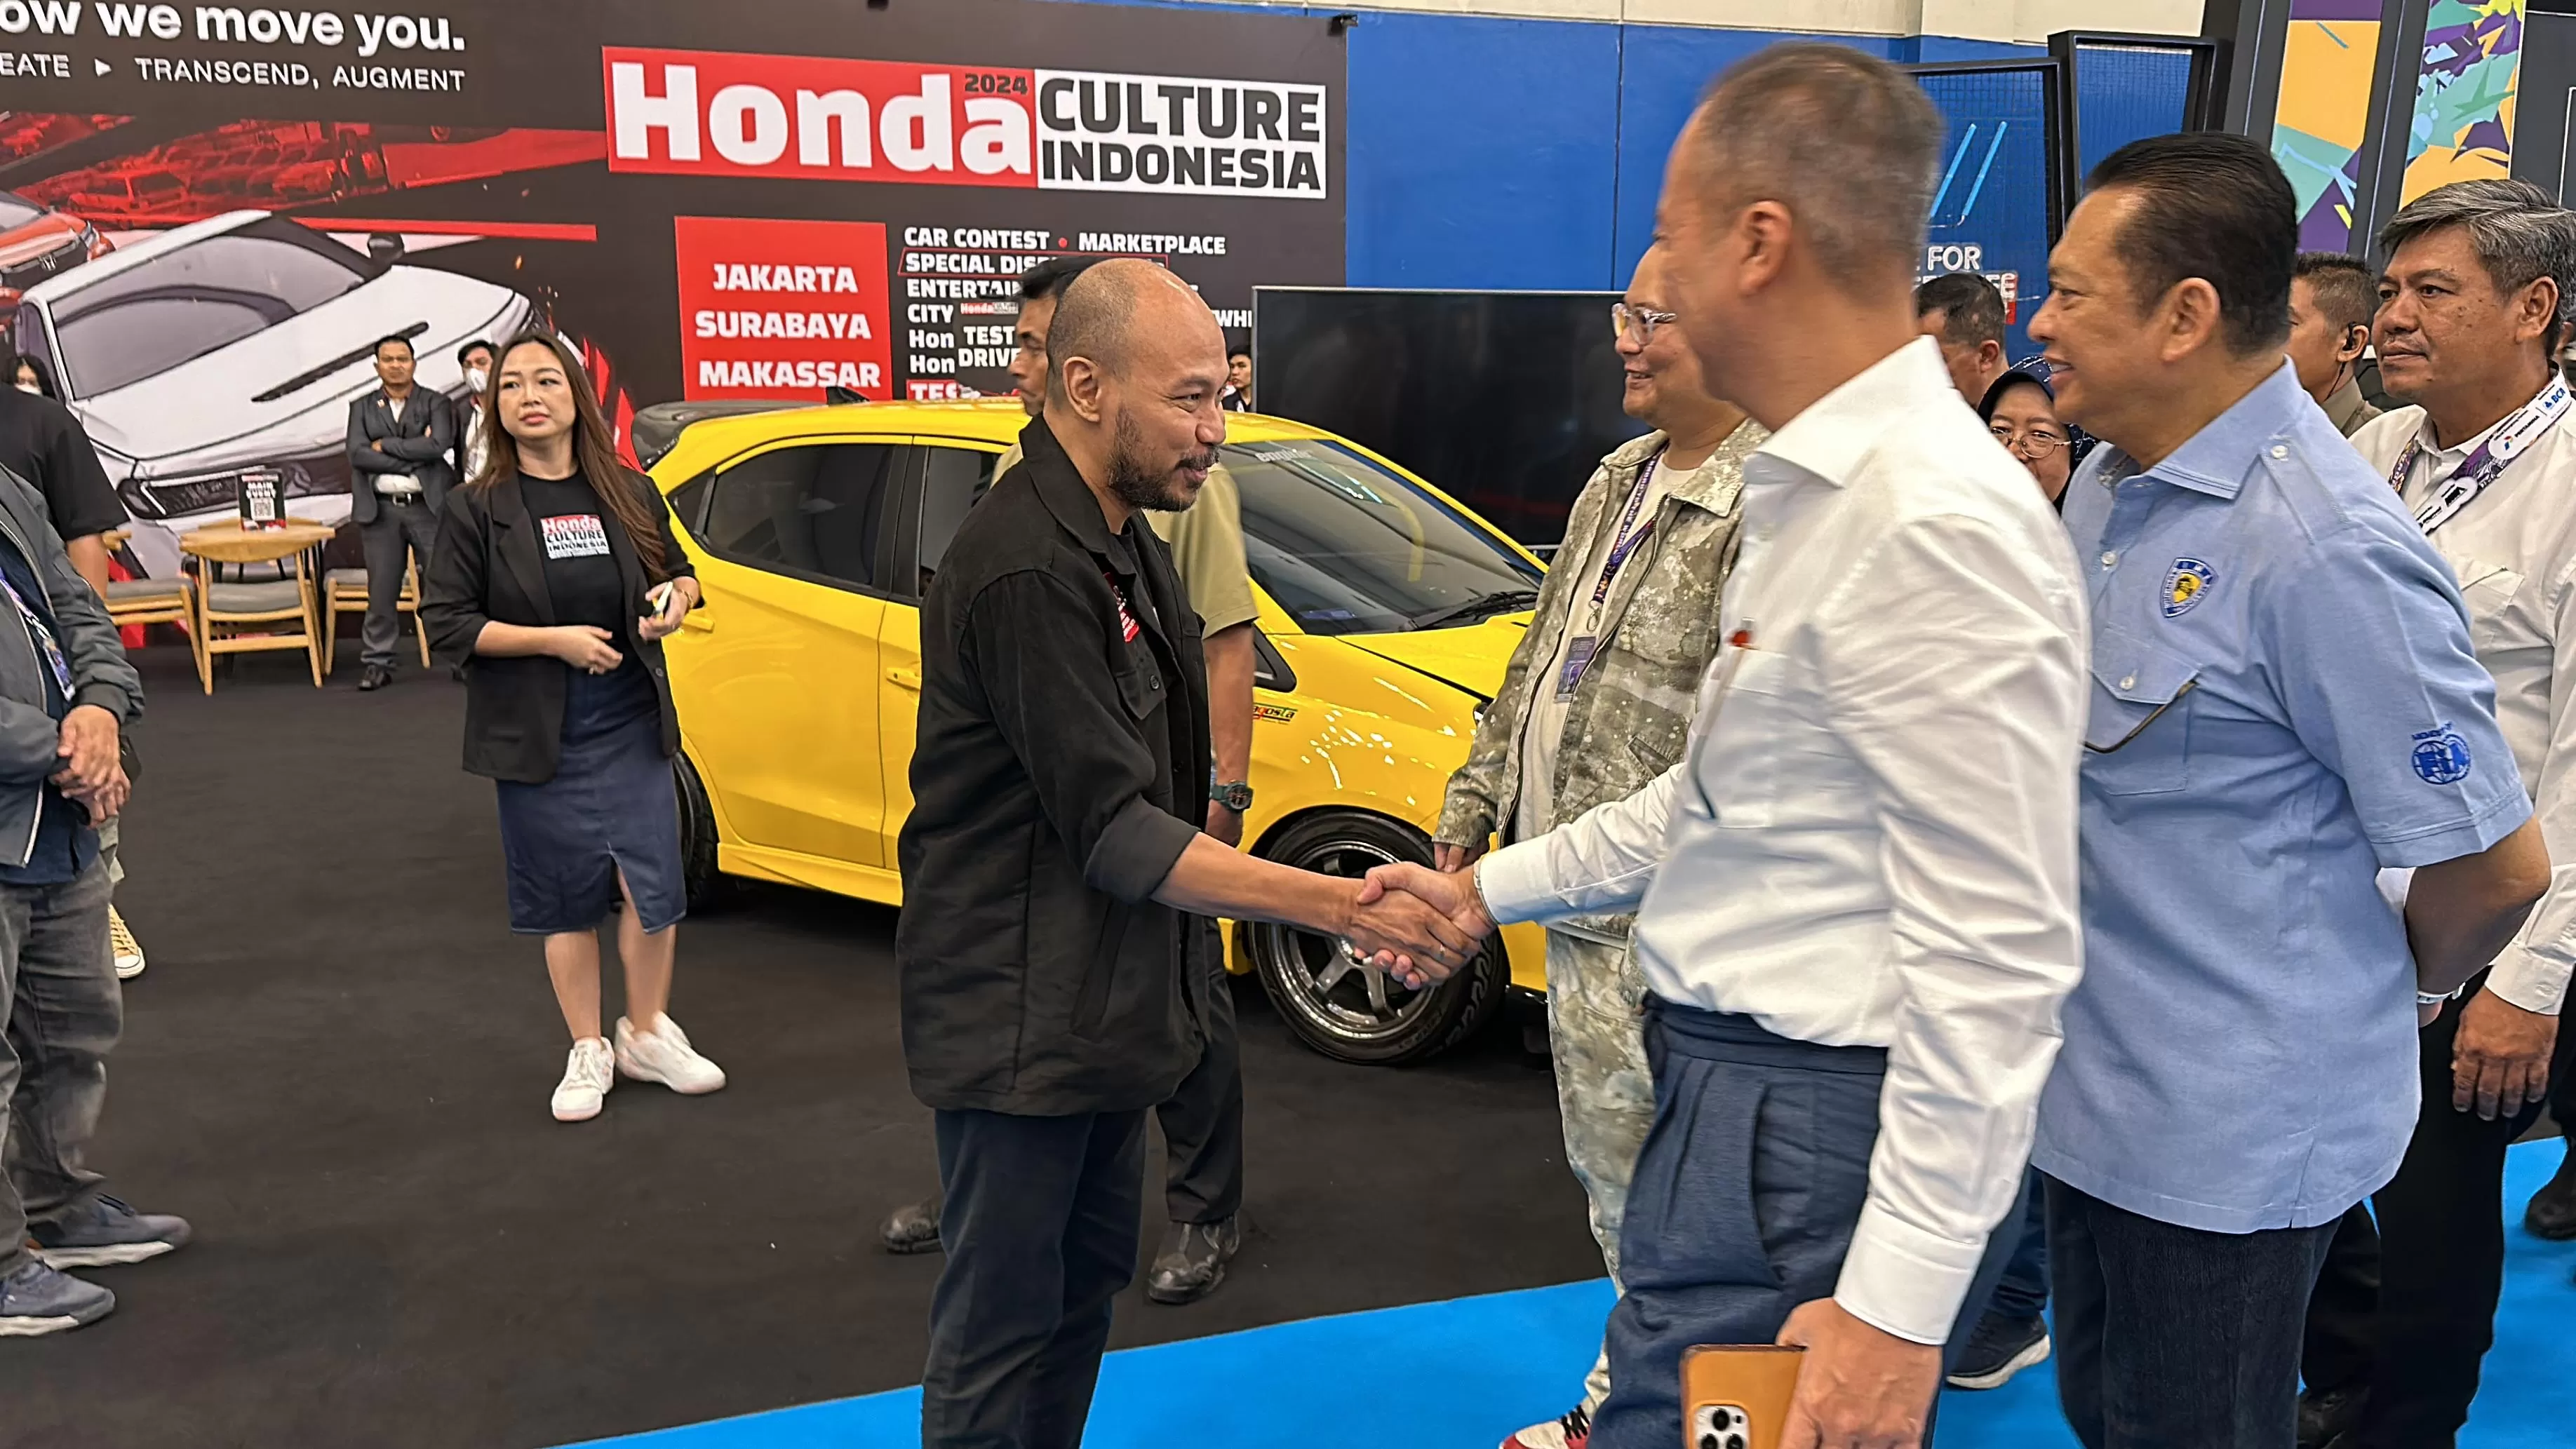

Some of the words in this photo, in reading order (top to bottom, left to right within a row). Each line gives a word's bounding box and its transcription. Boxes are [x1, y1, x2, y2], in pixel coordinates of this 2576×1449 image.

[0, 0, 81, 34] ow
[95, 3, 182, 39] we
[196, 6, 344, 46] move
[354, 13, 465, 57] you.
[0, 53, 71, 78] EATE
[134, 58, 319, 90] TRANSCEND,
[333, 65, 465, 91] AUGMENT
[965, 73, 1028, 95] 2024
[612, 62, 1031, 175] Honda
[1040, 79, 1320, 142] CULTURE
[1042, 140, 1321, 190] INDONESIA
[904, 227, 948, 247] CAR
[954, 229, 1049, 250] CONTEST
[1079, 232, 1226, 255] MARKETPLACE
[906, 252, 995, 274] SPECIAL
[1928, 245, 1981, 271] FOR
[713, 264, 859, 292] JAKARTA
[695, 311, 872, 339] SURABAYA
[907, 304, 954, 323] CITY
[909, 330, 954, 348] Hon
[963, 325, 1016, 345] TEST
[699, 360, 881, 387] MAKASSAR
[910, 355, 955, 373] Hon
[540, 515, 603, 534] Honda
[546, 530, 603, 543] CULTURE
[549, 541, 607, 551] INDONESIA
